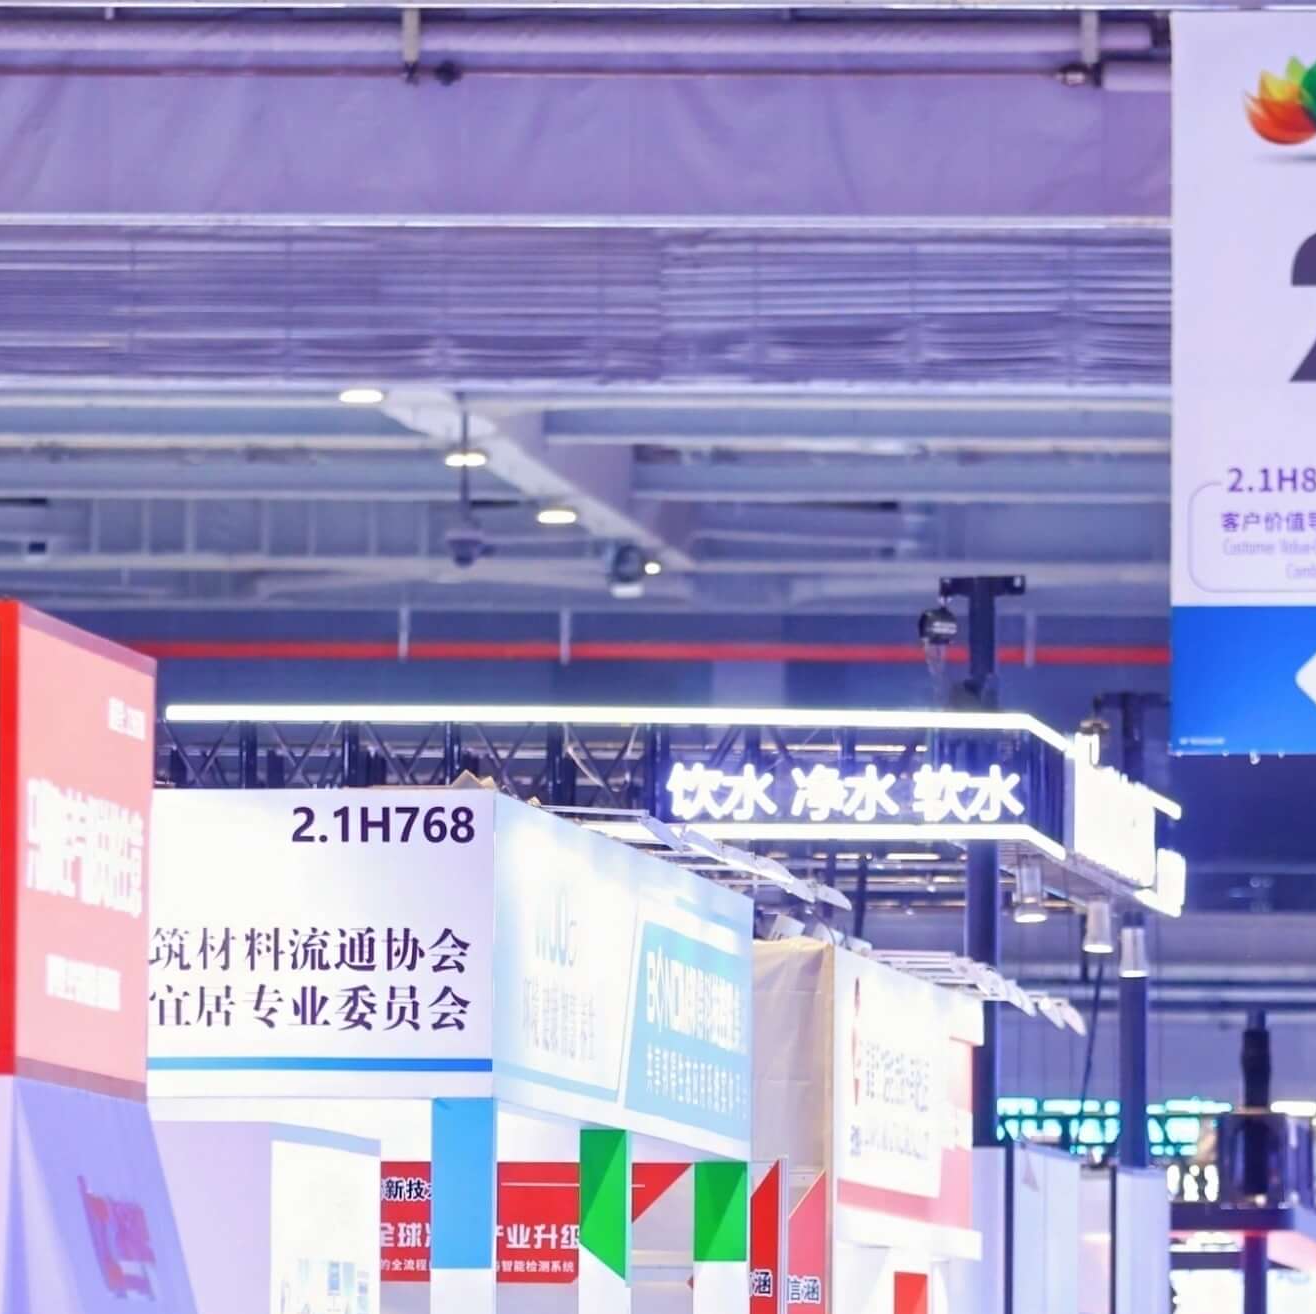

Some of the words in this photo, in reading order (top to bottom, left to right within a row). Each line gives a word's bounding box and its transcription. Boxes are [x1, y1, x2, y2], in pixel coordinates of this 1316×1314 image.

[666, 763, 778, 820] 饮水
[790, 764, 900, 822] 净水
[912, 764, 1025, 822] 软水
[291, 806, 477, 844] 2.1H768
[149, 926, 471, 975] 筑材料流通协会
[149, 984, 471, 1033] 宜居专业委员会
[380, 1221, 430, 1248] 全球
